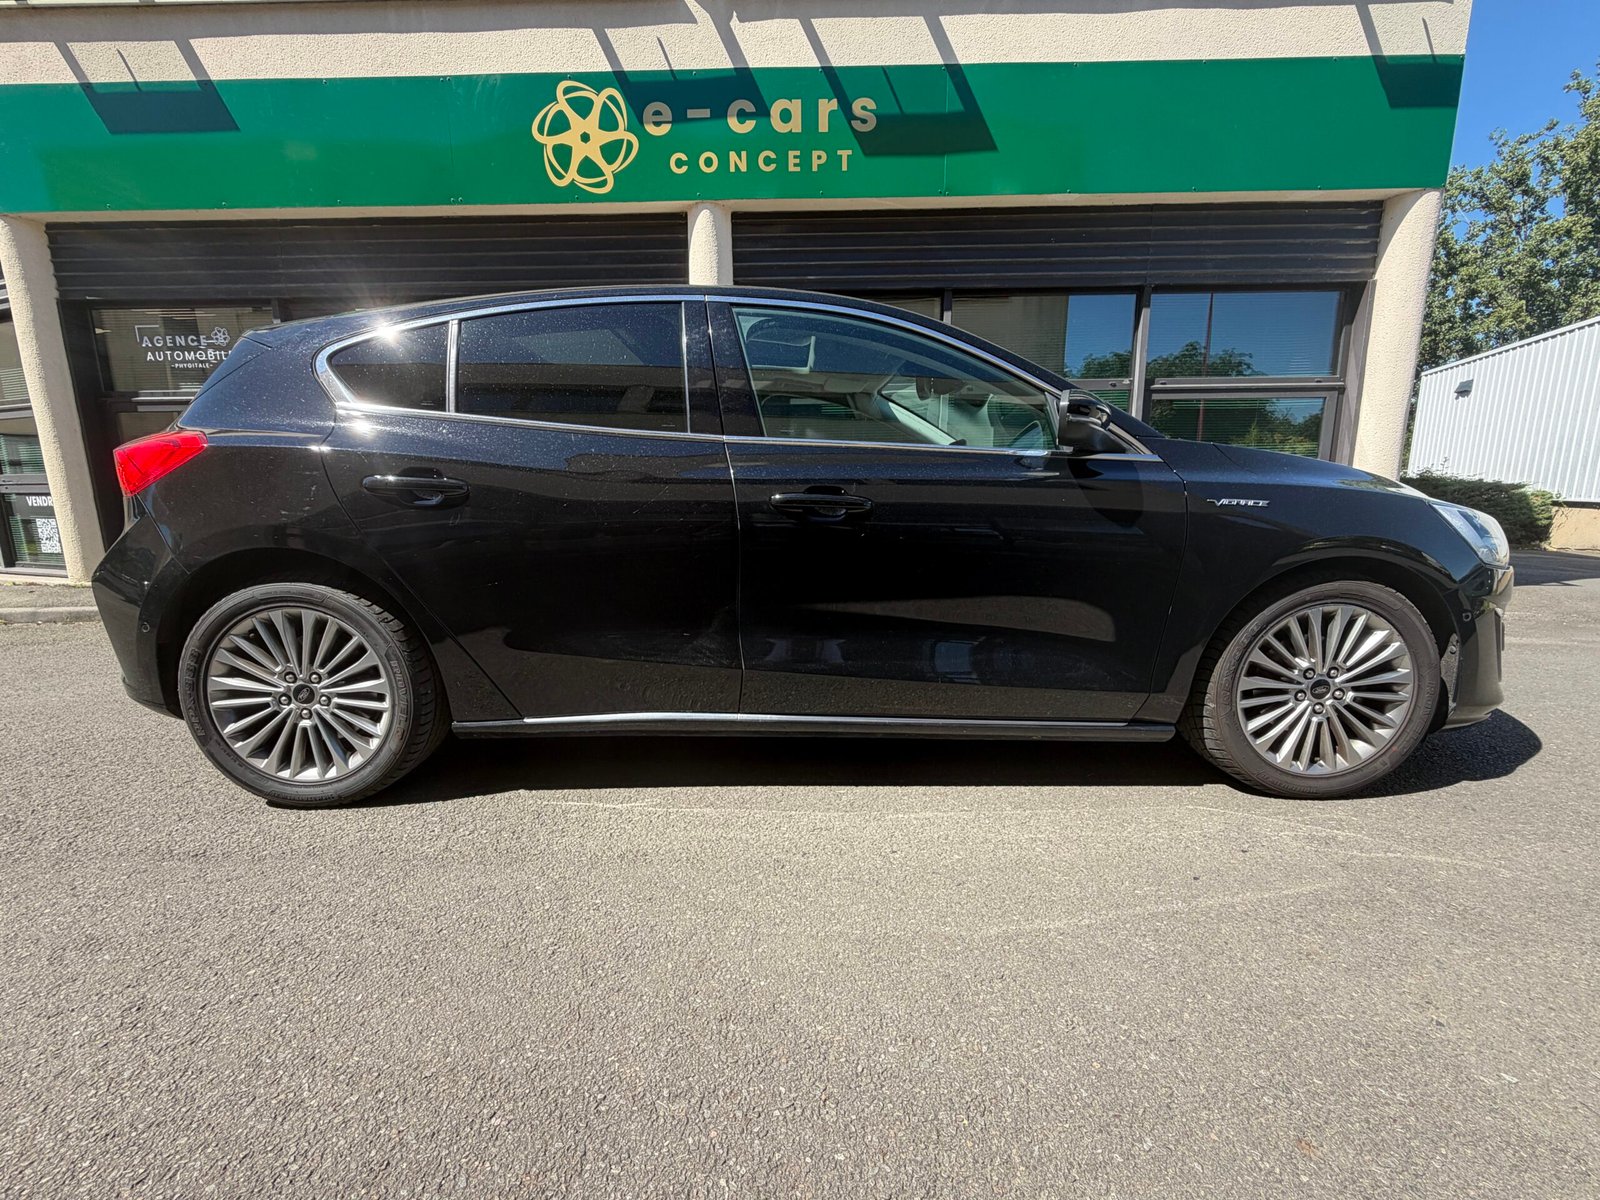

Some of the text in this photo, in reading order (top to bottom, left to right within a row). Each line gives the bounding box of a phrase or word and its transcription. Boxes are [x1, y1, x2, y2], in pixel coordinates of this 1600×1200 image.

[668, 149, 853, 174] CONCEPT
[141, 335, 208, 347] AGENCE
[146, 350, 232, 361] AUTOMOBIL
[26, 495, 54, 506] VENDR
